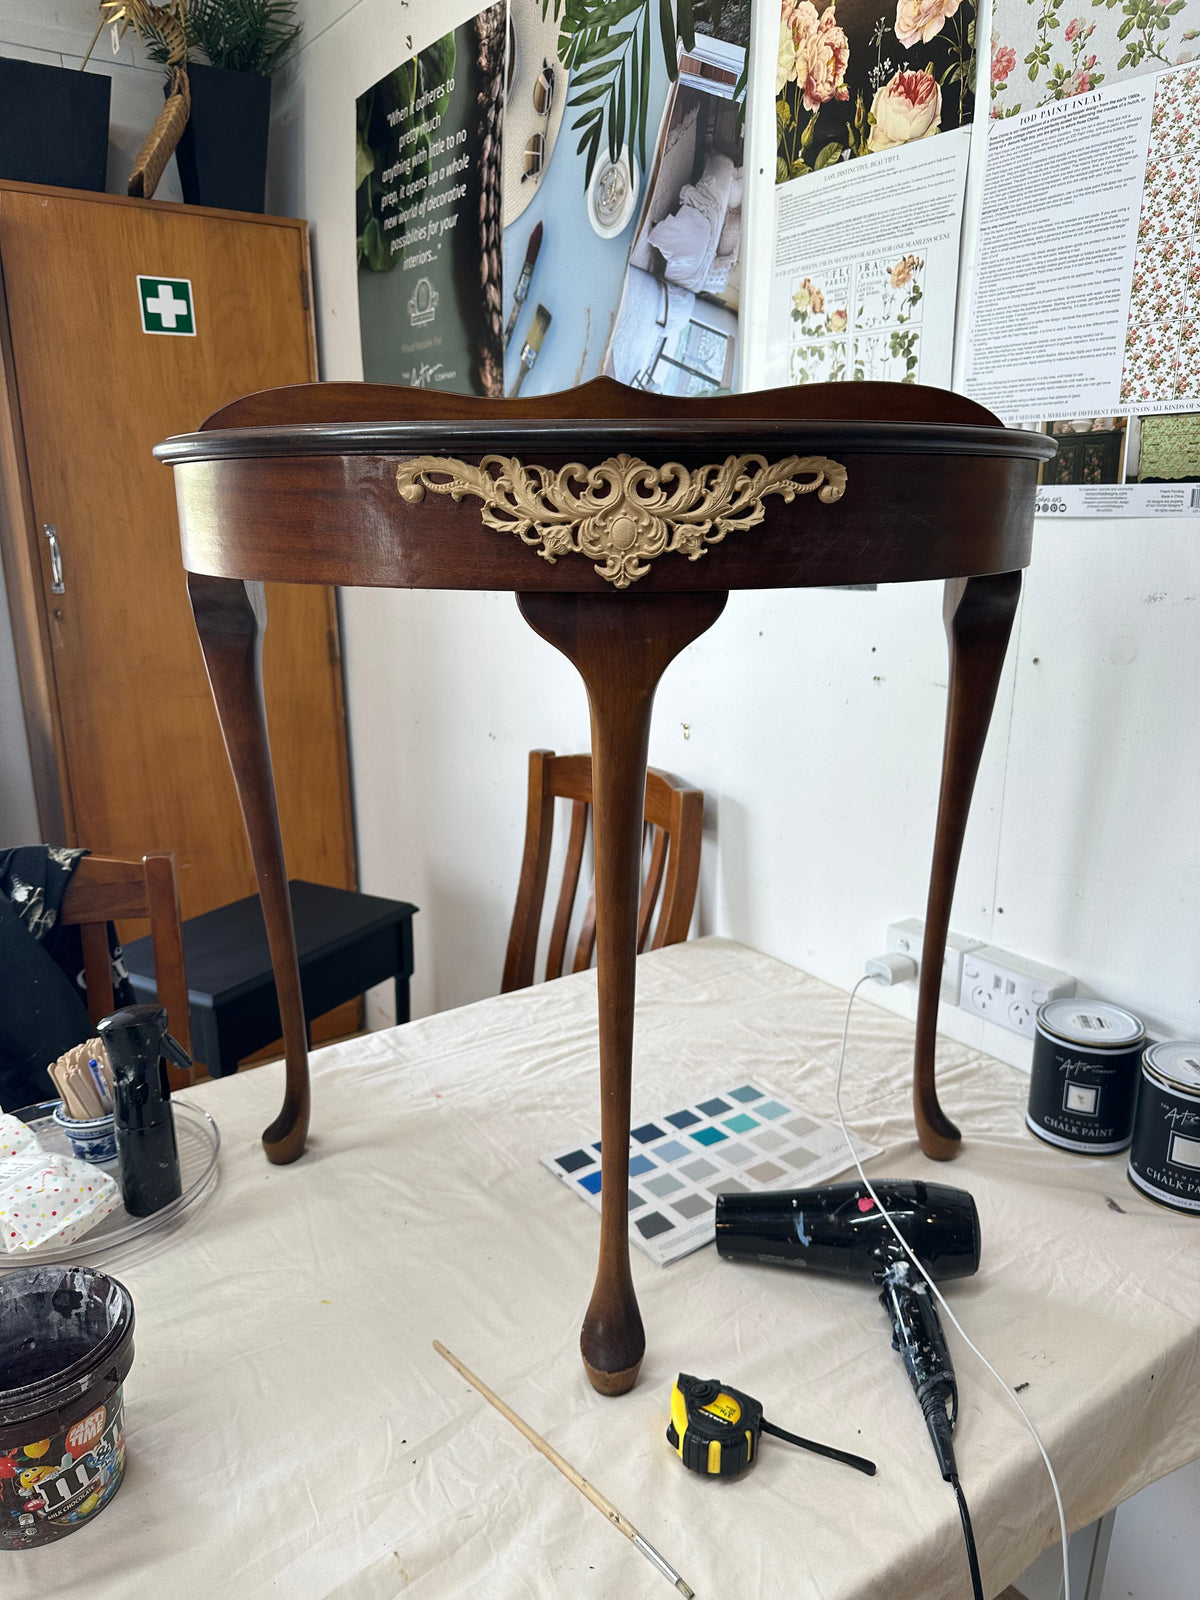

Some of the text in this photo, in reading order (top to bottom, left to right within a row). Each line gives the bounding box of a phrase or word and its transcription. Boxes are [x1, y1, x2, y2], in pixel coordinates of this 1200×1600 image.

[416, 84, 445, 111] adheres
[446, 78, 455, 93] to
[1020, 93, 1103, 125] IOD PAINT INLAY
[399, 112, 441, 152] pretty much
[382, 129, 467, 184] anything with little to no
[400, 185, 405, 199] it
[406, 176, 427, 198] opens
[428, 170, 438, 188] up
[439, 168, 445, 180] a
[446, 153, 469, 177] whole
[384, 184, 466, 231] new world of decorative
[427, 220, 439, 241] for
[439, 214, 459, 236] your
[1044, 1116, 1114, 1137] CHALK PAINT
[1146, 1166, 1184, 1190] CHALK
[1162, 1168, 1200, 1183] PREMIU
[69, 1420, 104, 1447] TIME
[47, 1486, 95, 1520] MILK CHOCOLATE
